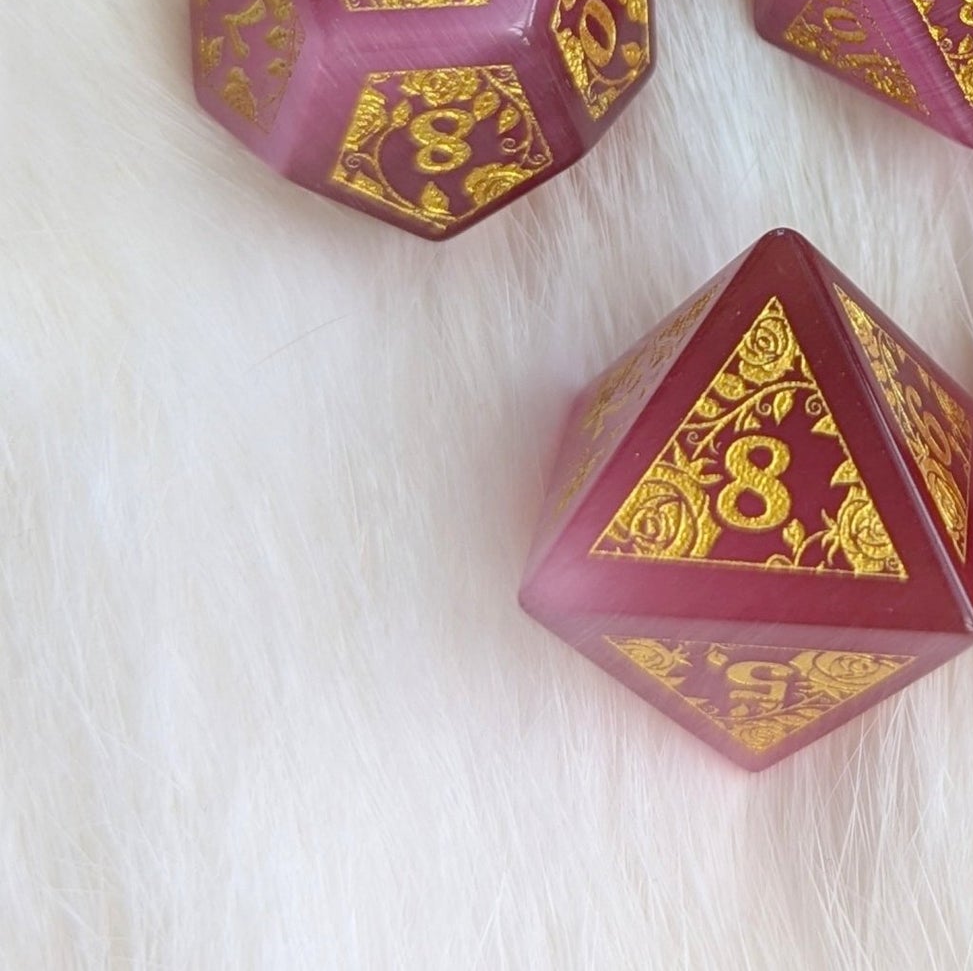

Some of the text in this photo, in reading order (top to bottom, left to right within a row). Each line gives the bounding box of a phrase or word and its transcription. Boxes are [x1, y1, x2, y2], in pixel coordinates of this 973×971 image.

[410, 108, 476, 173] 8
[717, 436, 790, 532] 8
[725, 661, 791, 702] 5
